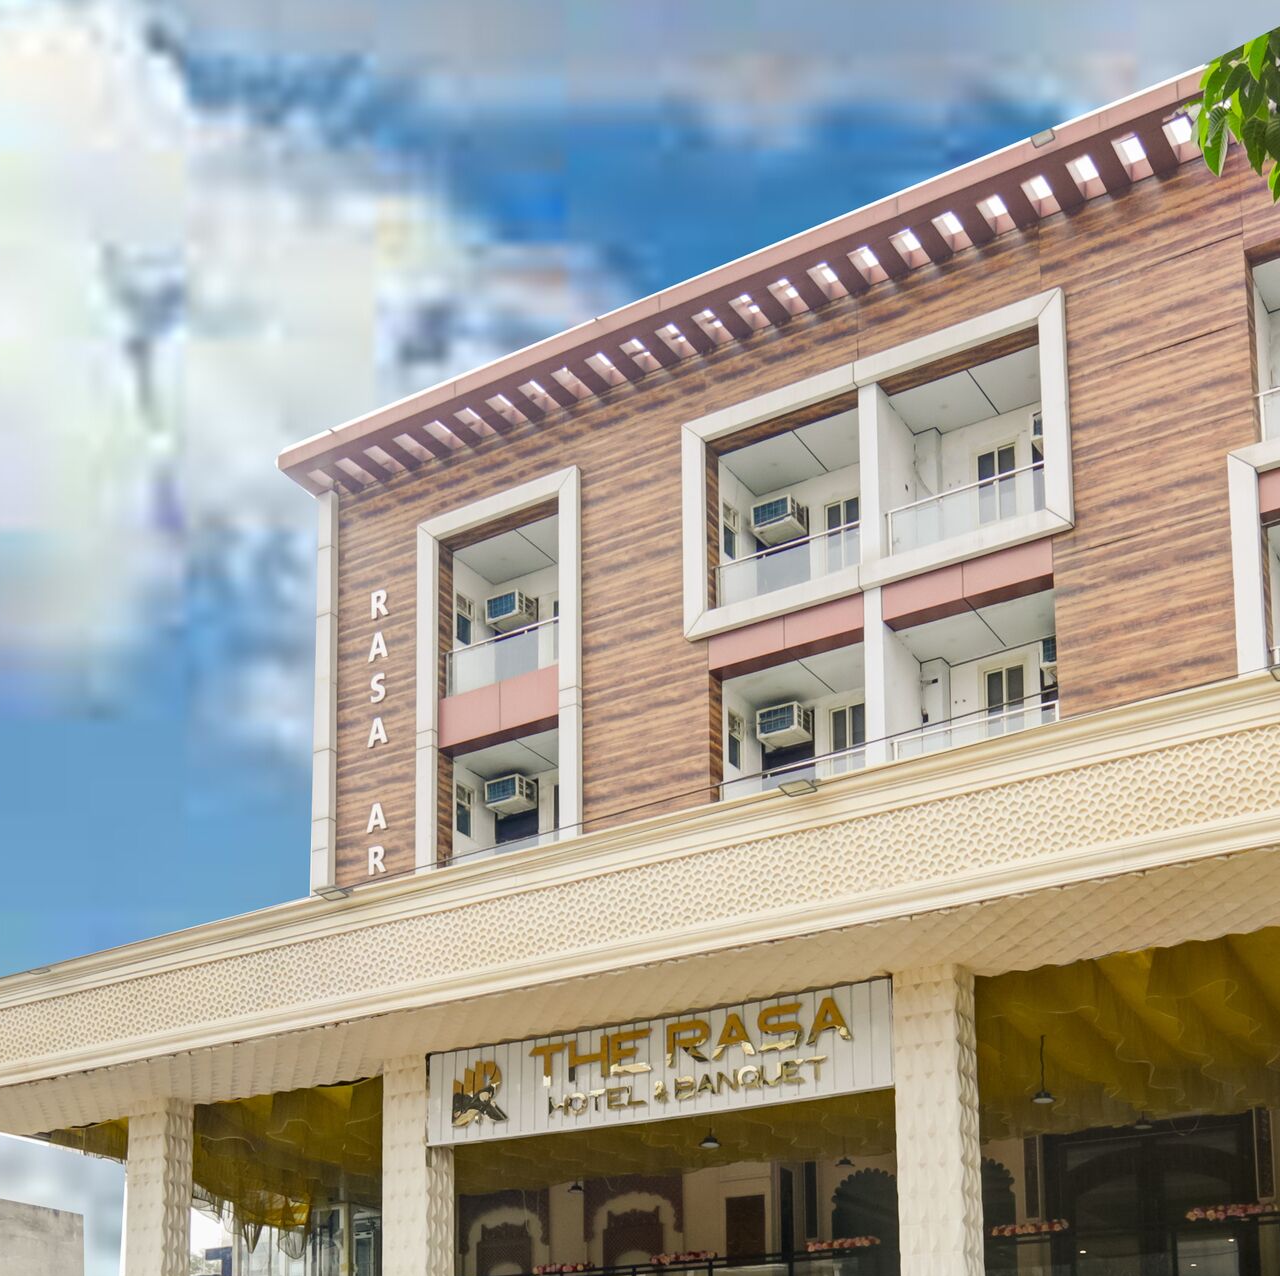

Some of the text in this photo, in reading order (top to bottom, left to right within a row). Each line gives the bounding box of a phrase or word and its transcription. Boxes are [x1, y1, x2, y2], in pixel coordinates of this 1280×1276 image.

[367, 588, 390, 748] RASA
[529, 997, 854, 1088] THE RASA
[548, 1055, 828, 1117] HOTEL & BANQUET
